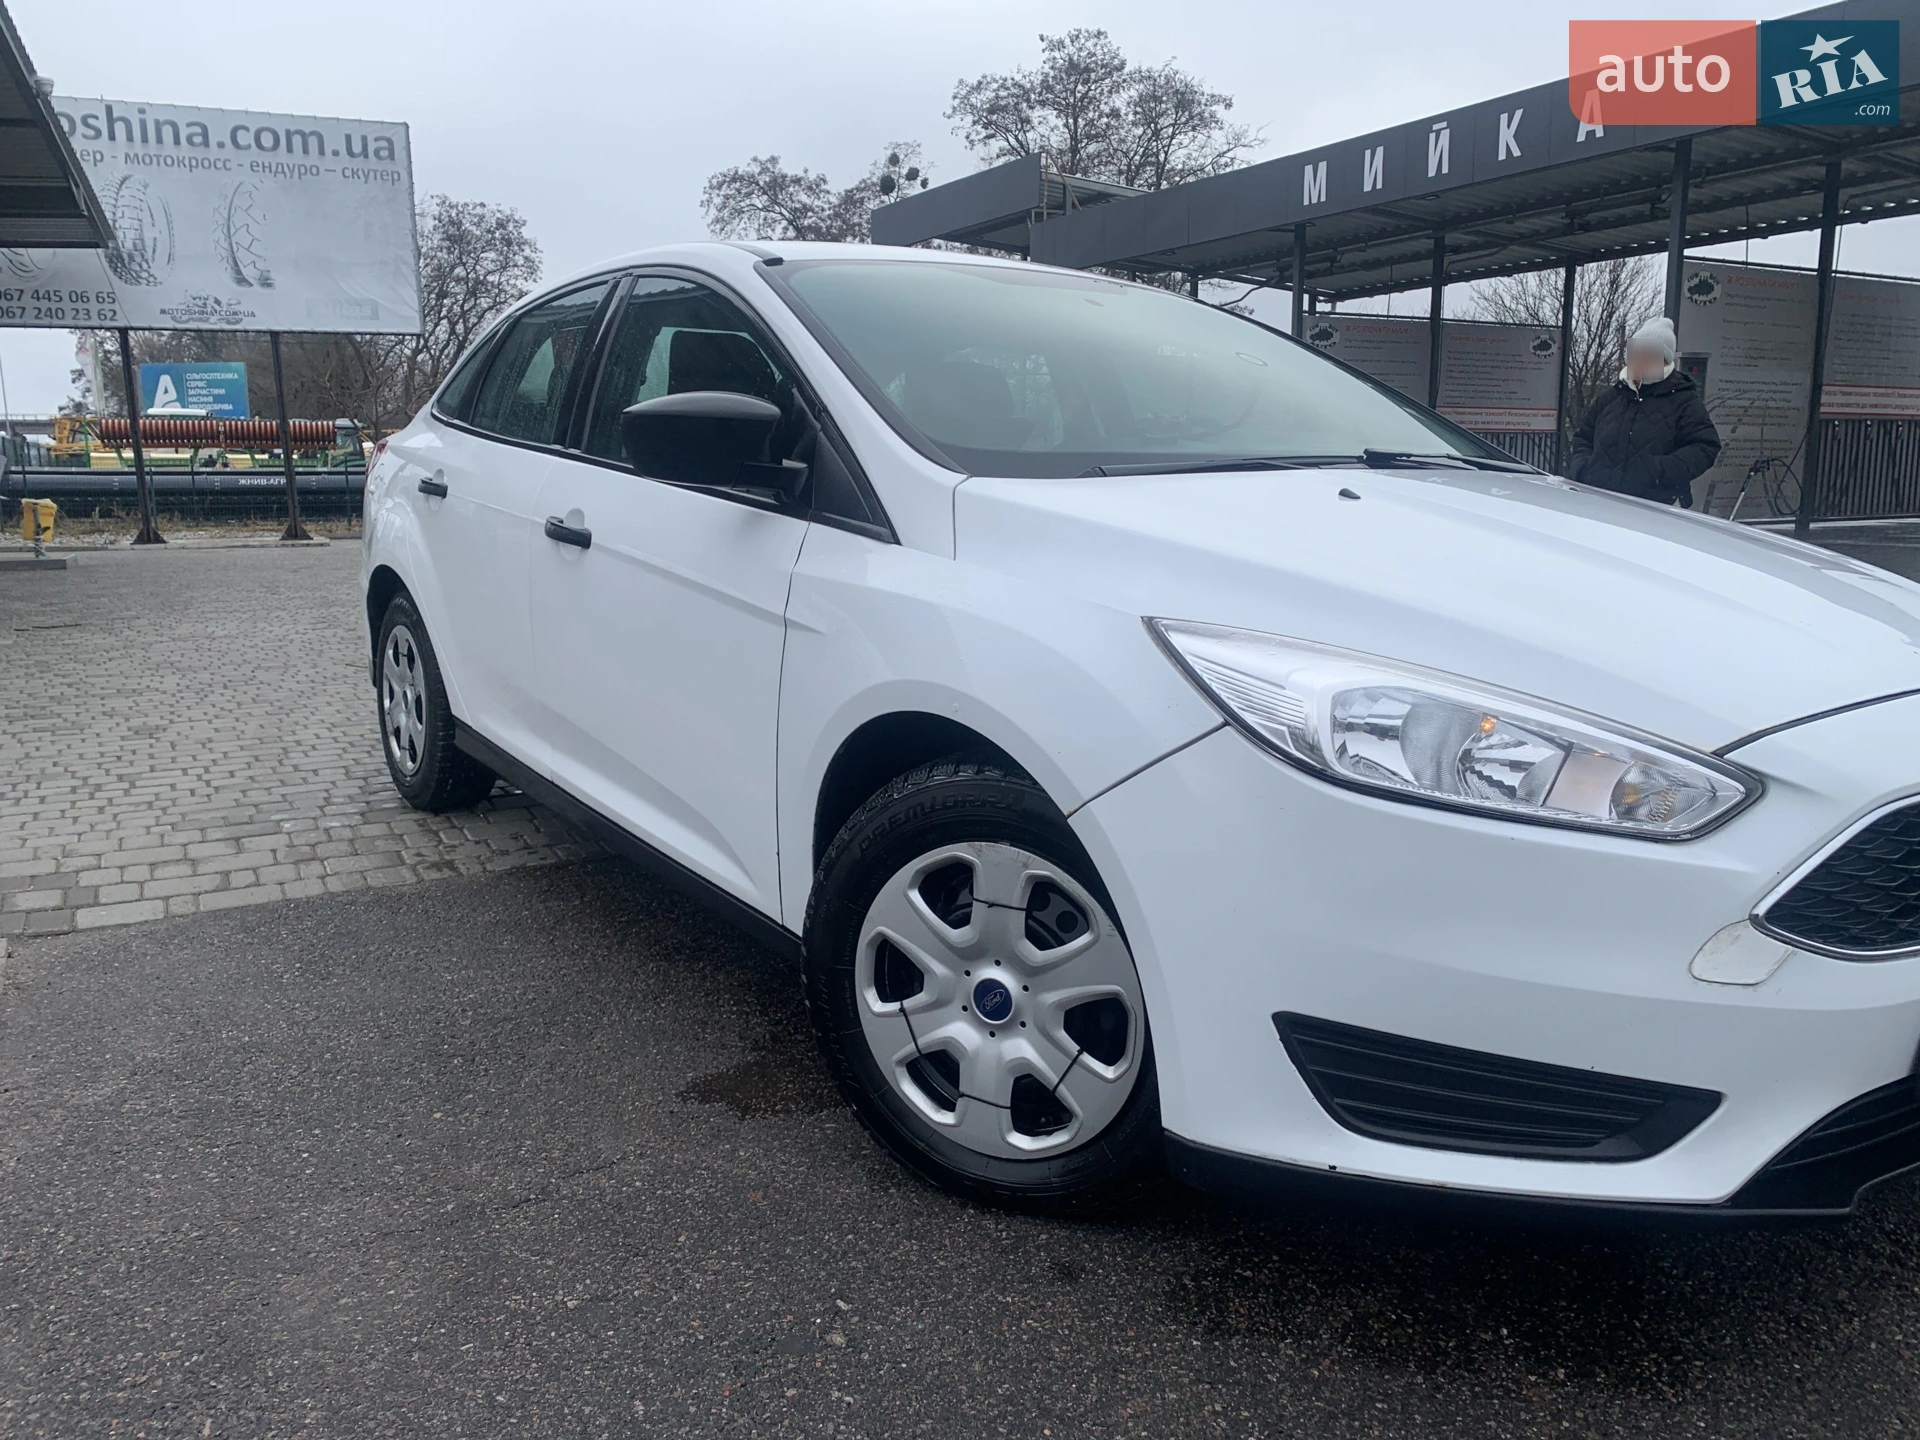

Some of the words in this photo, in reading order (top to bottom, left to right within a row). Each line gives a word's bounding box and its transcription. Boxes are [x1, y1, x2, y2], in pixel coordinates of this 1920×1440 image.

[74, 148, 105, 167] ер
[124, 152, 232, 173] мотокросс
[250, 160, 320, 179] ендуро
[342, 165, 401, 186] скутер
[0, 288, 24, 302] 67
[30, 289, 63, 303] 445
[68, 290, 90, 303] 06
[95, 291, 116, 304] 65
[32, 306, 65, 320] 240
[70, 307, 92, 321] 23
[97, 308, 119, 321] 62
